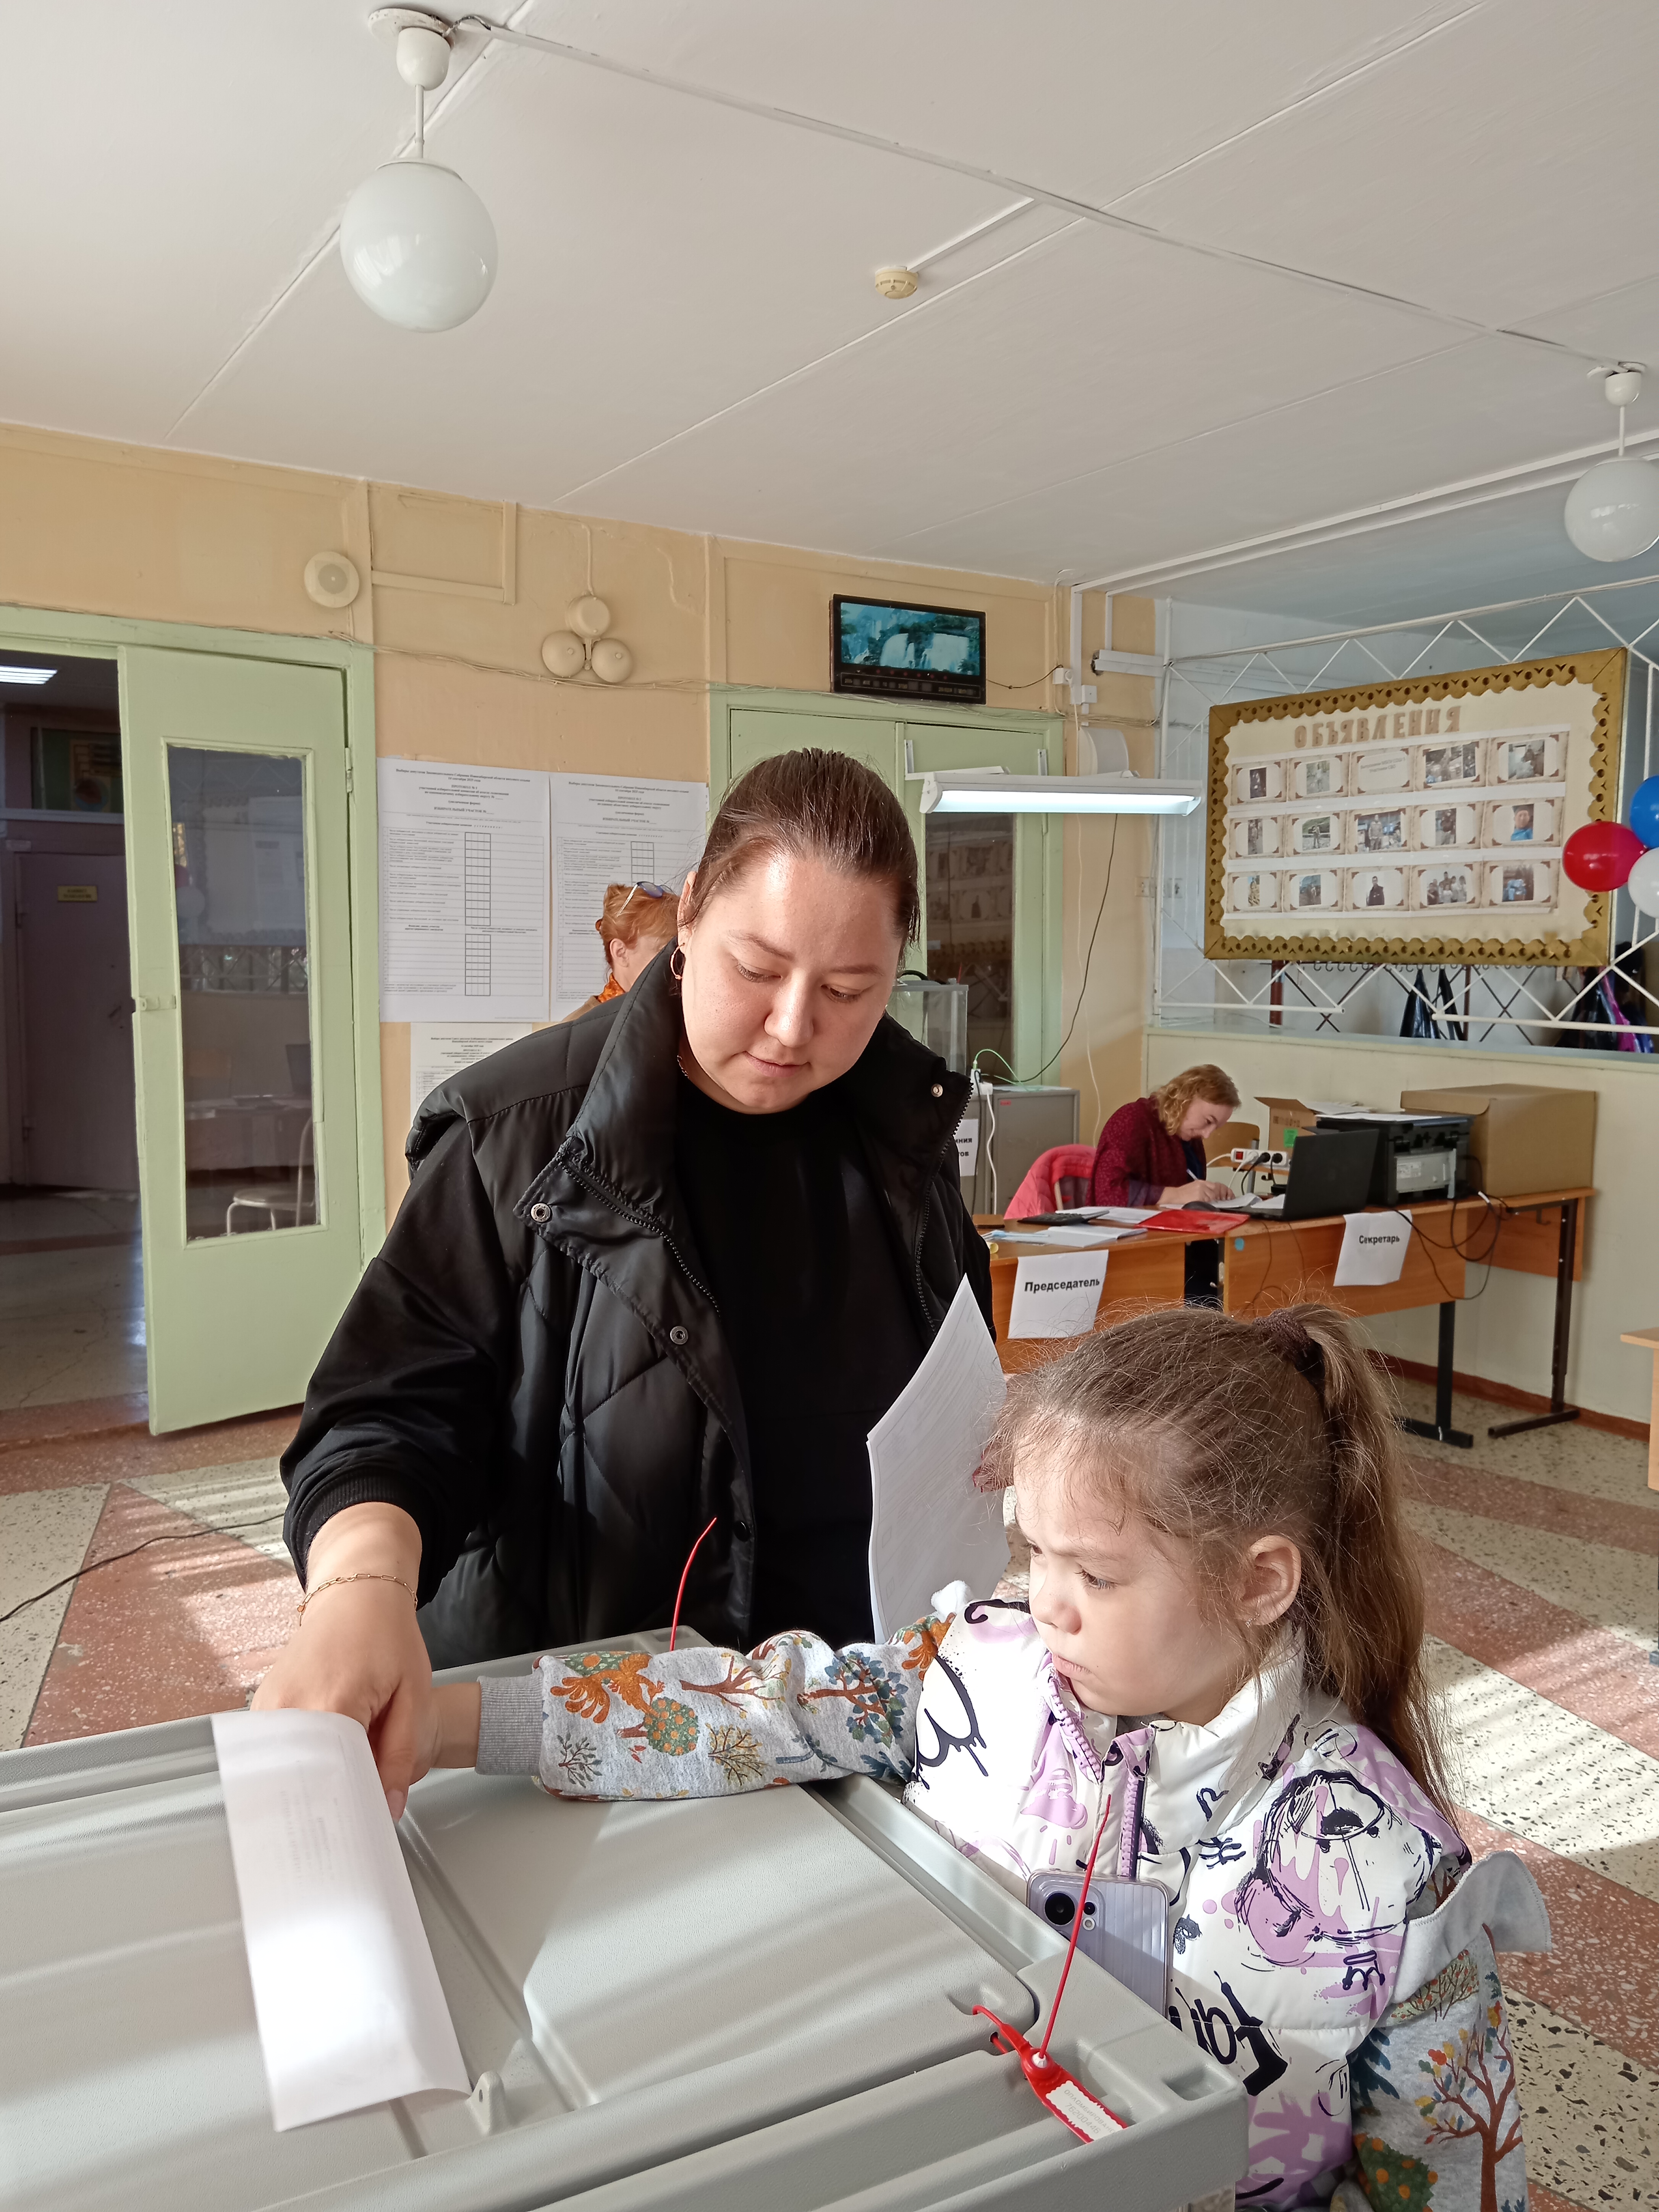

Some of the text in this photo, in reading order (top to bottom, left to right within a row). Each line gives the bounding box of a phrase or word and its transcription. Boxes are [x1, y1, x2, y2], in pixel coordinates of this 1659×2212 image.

[1294, 706, 1461, 748] ОБЪЯВЛЕНИЯ
[1359, 1235, 1400, 1245] Секретарь
[1024, 1278, 1100, 1294] Председатель
